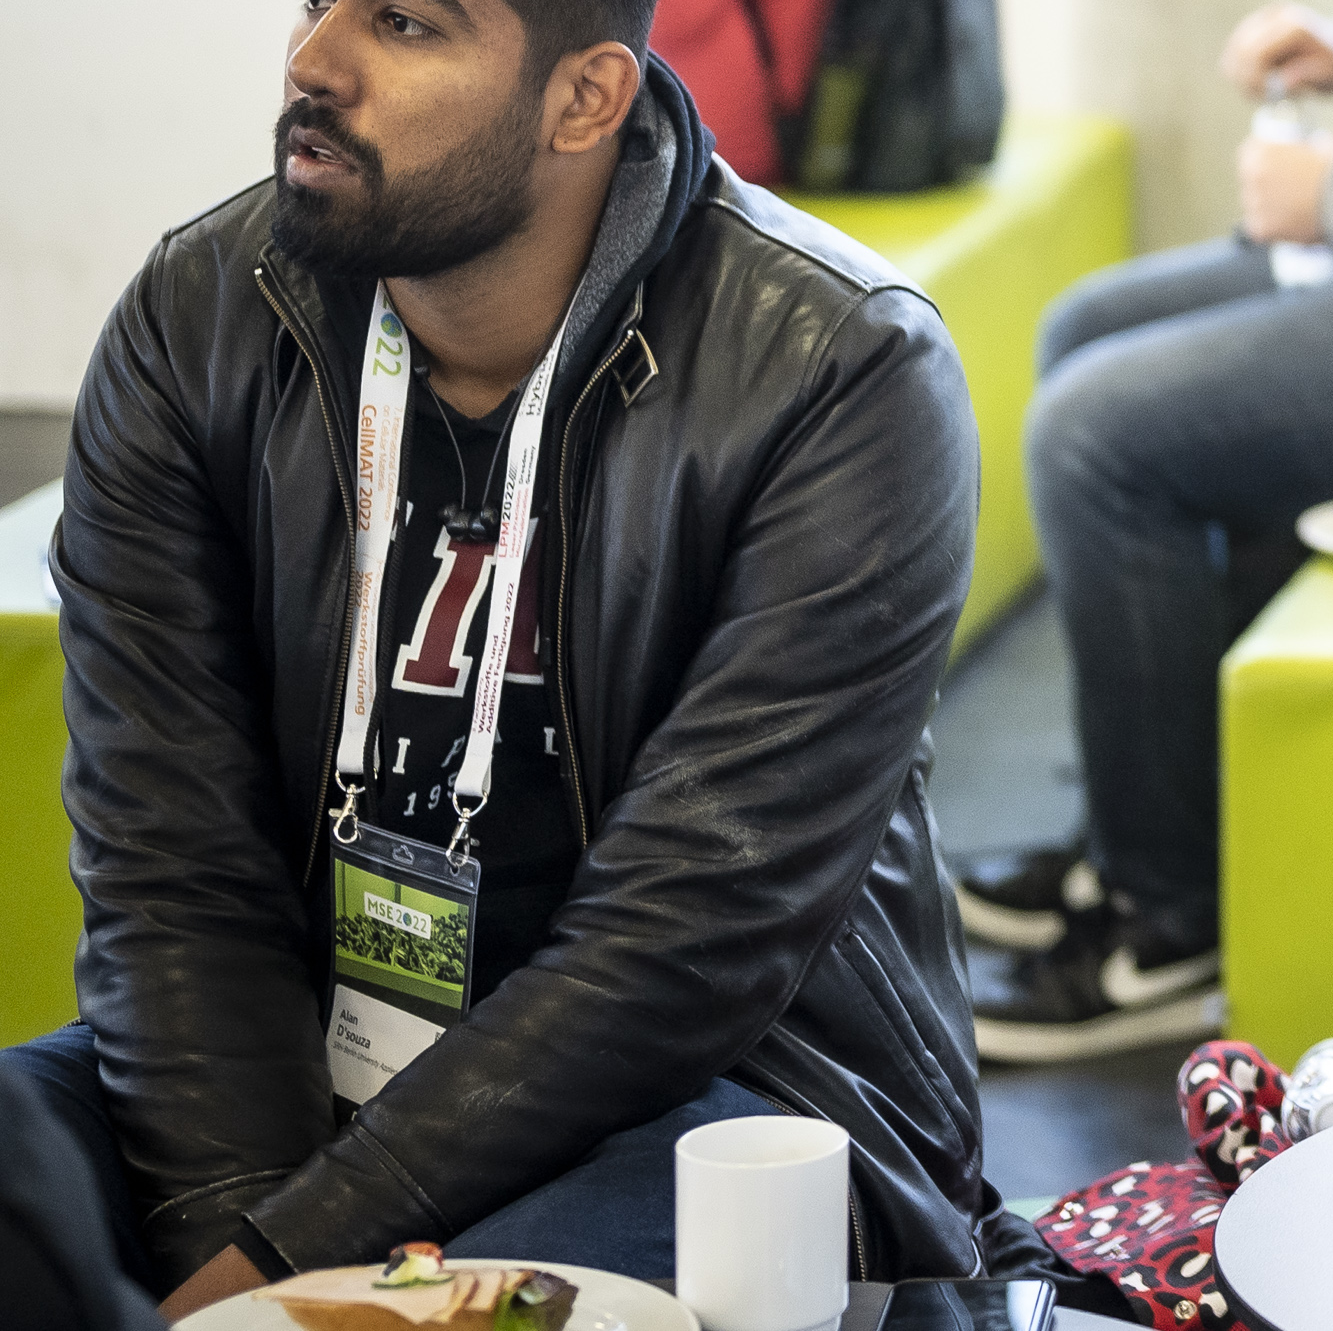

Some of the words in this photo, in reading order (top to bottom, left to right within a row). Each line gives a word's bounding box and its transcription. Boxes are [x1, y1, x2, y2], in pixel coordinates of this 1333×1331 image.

[358, 404, 377, 483] CellMAT
[358, 486, 374, 532] 2022
[354, 570, 373, 717] Werkstoffprüfung
[486, 679, 499, 734] Additive
[493, 615, 511, 675] Fertigung
[503, 581, 515, 613] 2022
[477, 662, 494, 734] Werkstoffe
[489, 633, 500, 660] und
[336, 1023, 371, 1050] D'souza
[339, 1008, 359, 1026] Alan
